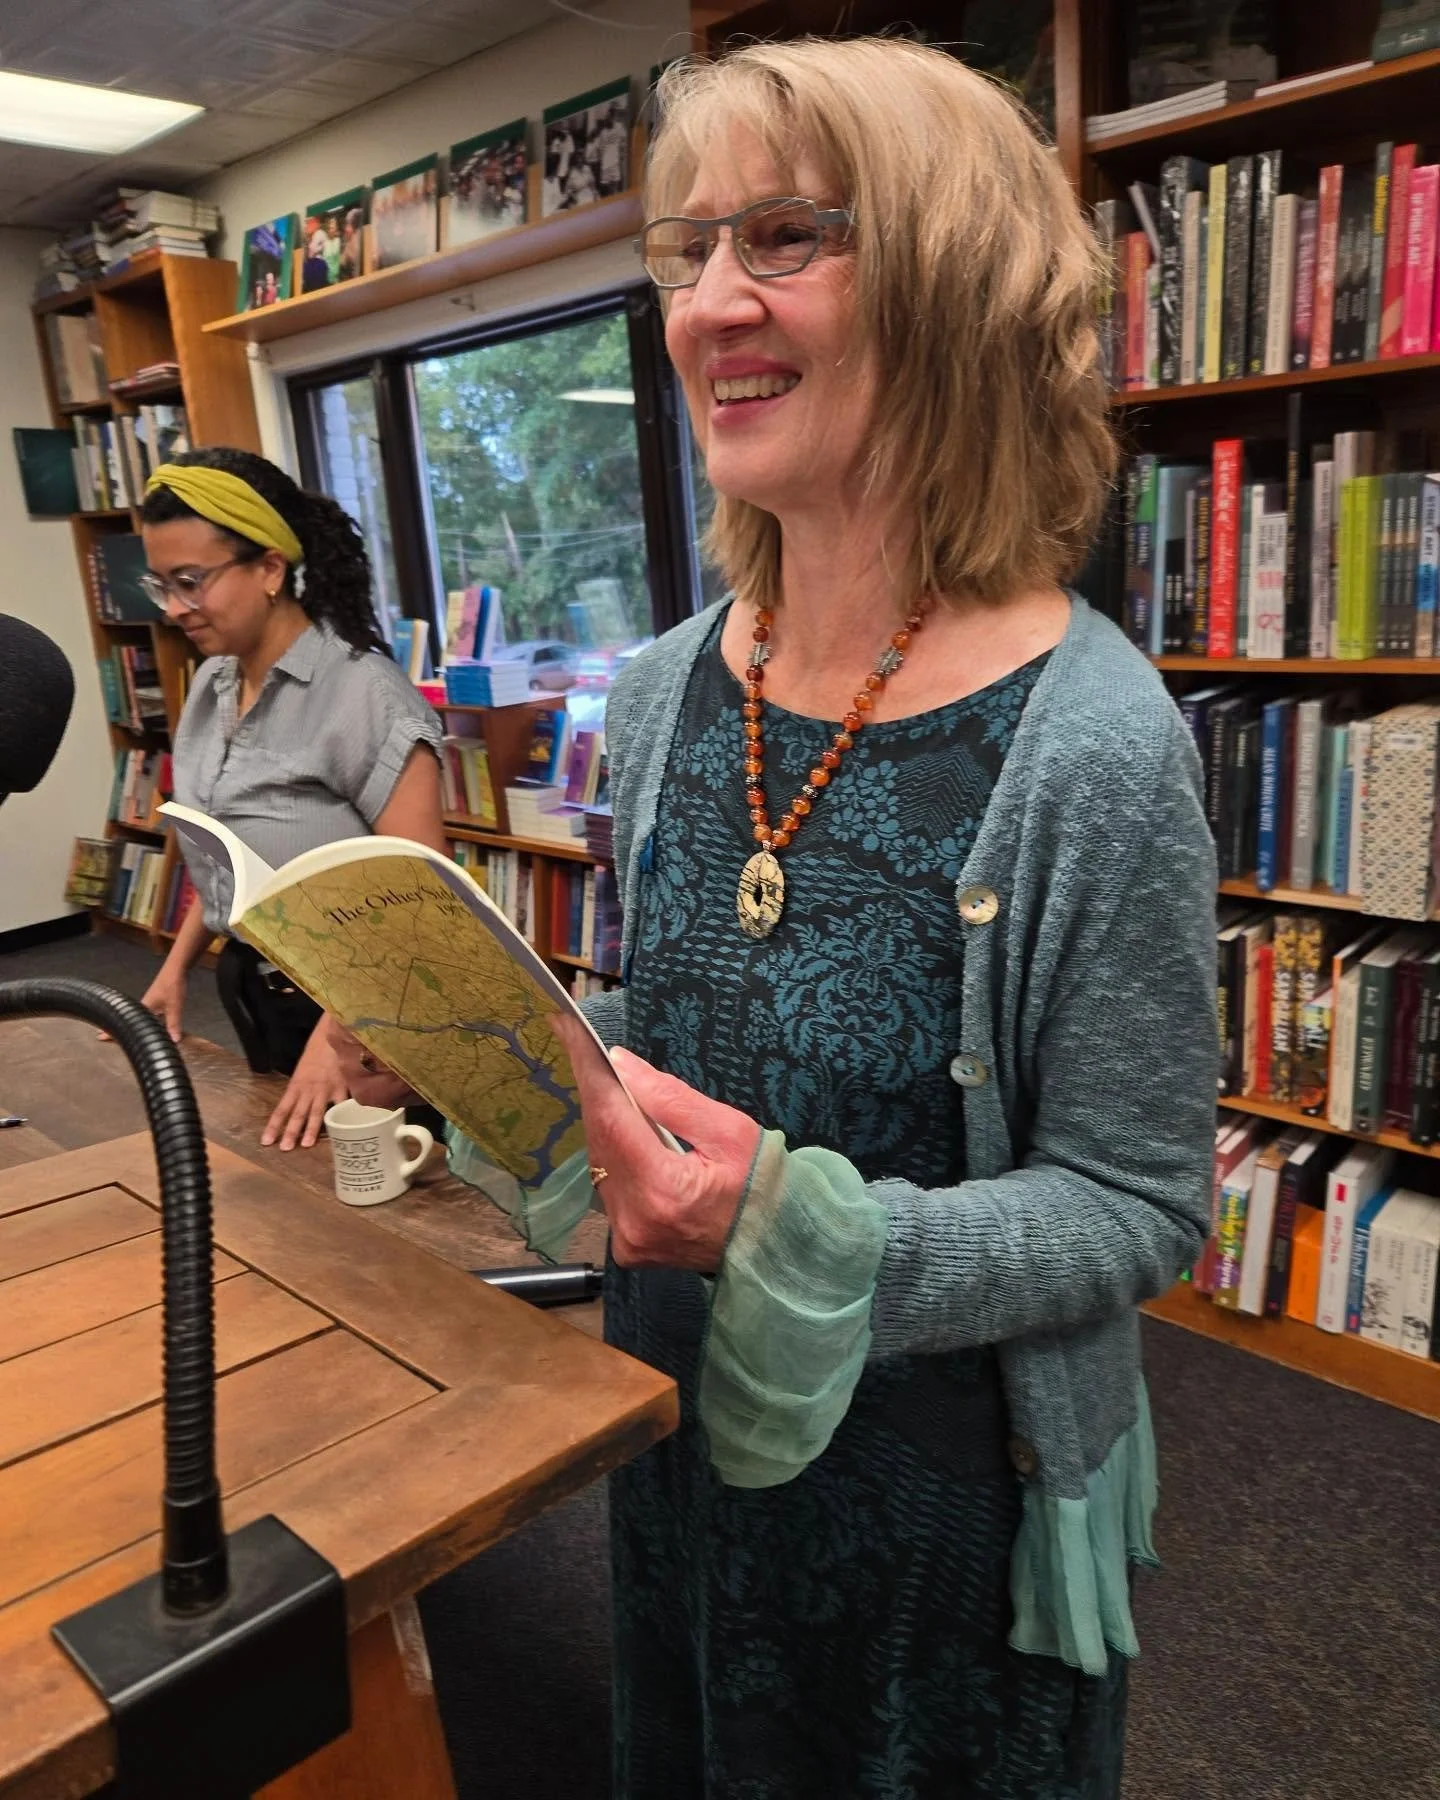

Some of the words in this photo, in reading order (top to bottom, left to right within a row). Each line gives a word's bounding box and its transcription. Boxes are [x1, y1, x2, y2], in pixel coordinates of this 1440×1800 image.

[1137, 525, 1152, 565] CHANEL
[322, 905, 368, 926] The
[365, 888, 424, 910] Other
[1273, 971, 1292, 1000] SAM
[1219, 1246, 1238, 1288] Pictures
